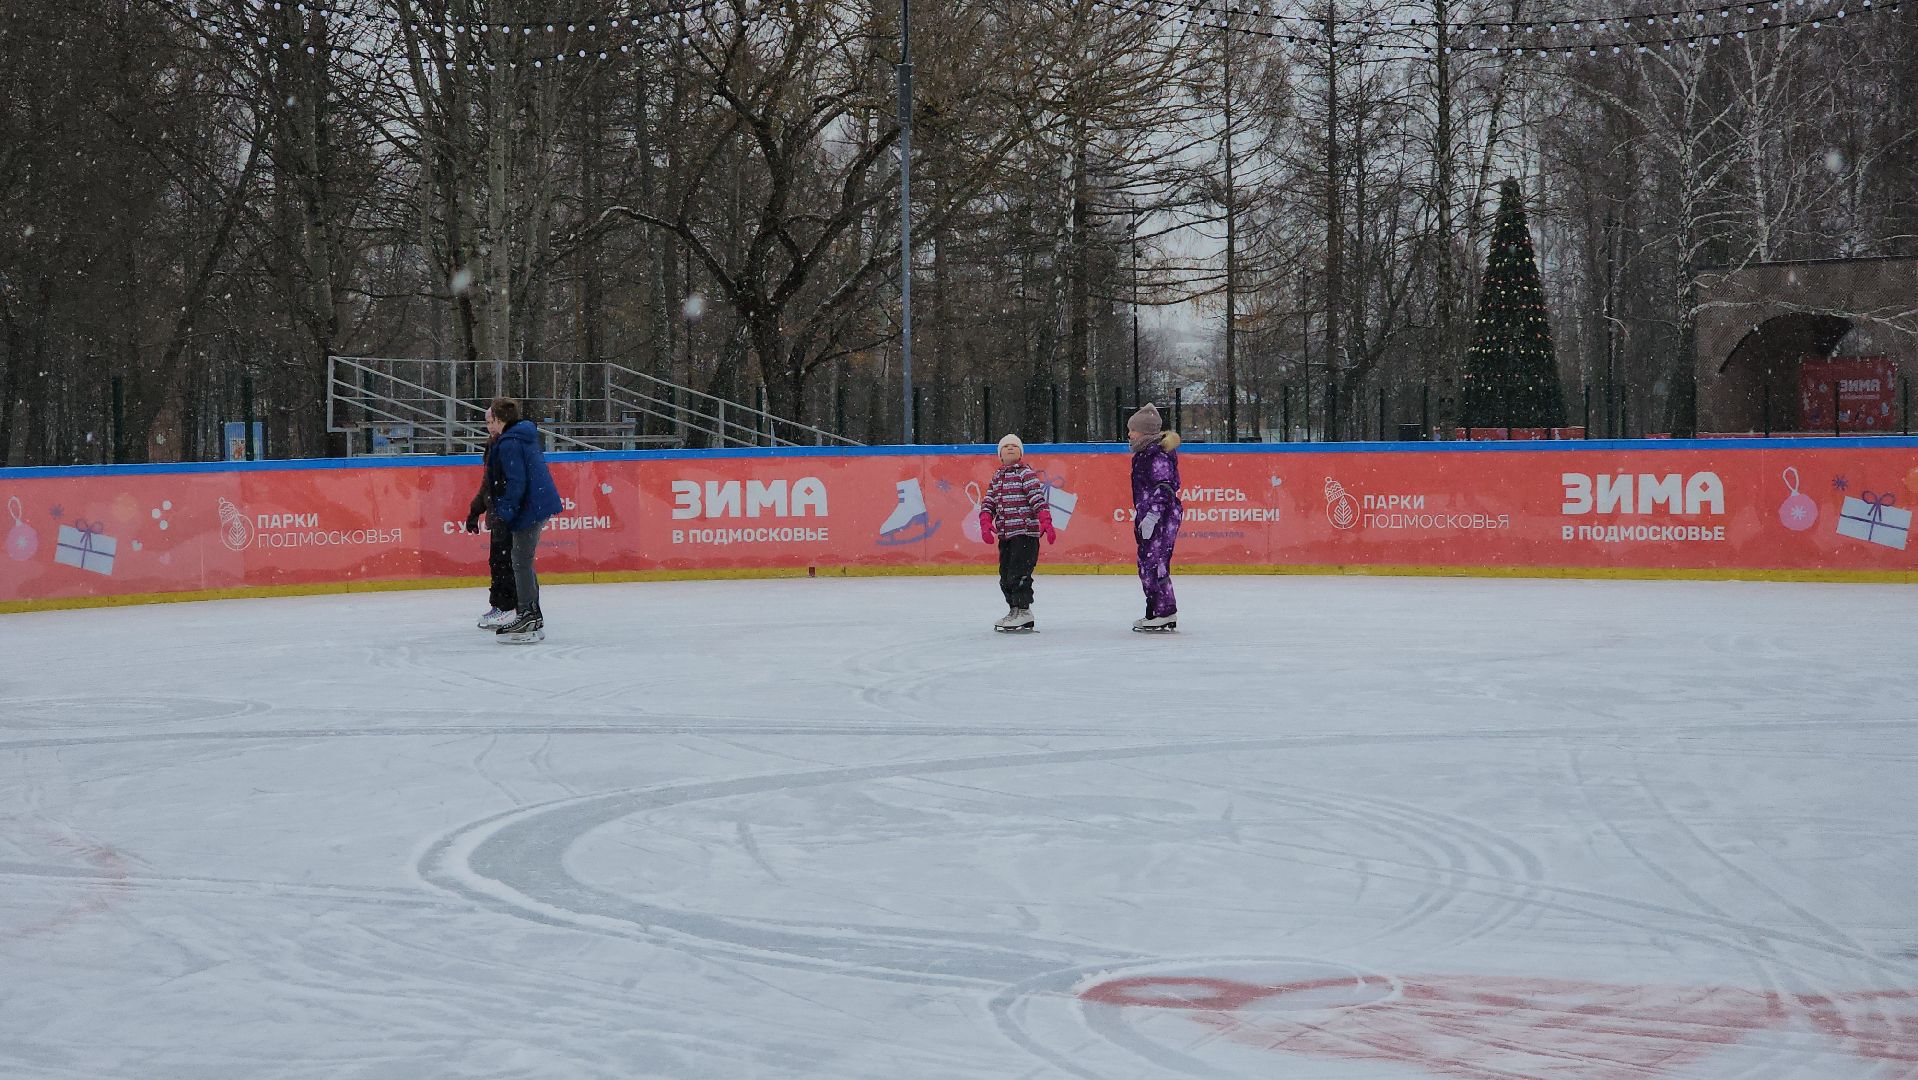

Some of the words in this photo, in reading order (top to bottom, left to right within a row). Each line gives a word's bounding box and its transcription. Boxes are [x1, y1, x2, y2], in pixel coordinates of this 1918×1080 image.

[1839, 379, 1880, 392] ЗИМА
[672, 476, 828, 519] ЗИМА
[1562, 471, 1725, 514] ЗИМА
[1363, 495, 1424, 510] ПАРКИ
[257, 513, 319, 528] ПАРКИ
[1113, 508, 1124, 522] С
[1364, 513, 1509, 529] ПОДМОСКОВЬЯ
[443, 520, 454, 534] С
[1562, 525, 1574, 541] В
[1578, 525, 1725, 542] ПОДМОСКОВЬЕ
[258, 528, 402, 548] ПОДМОСКОВЬЯ
[672, 529, 684, 544] В
[689, 527, 829, 545] ПОДМОСКОВЬЕ
